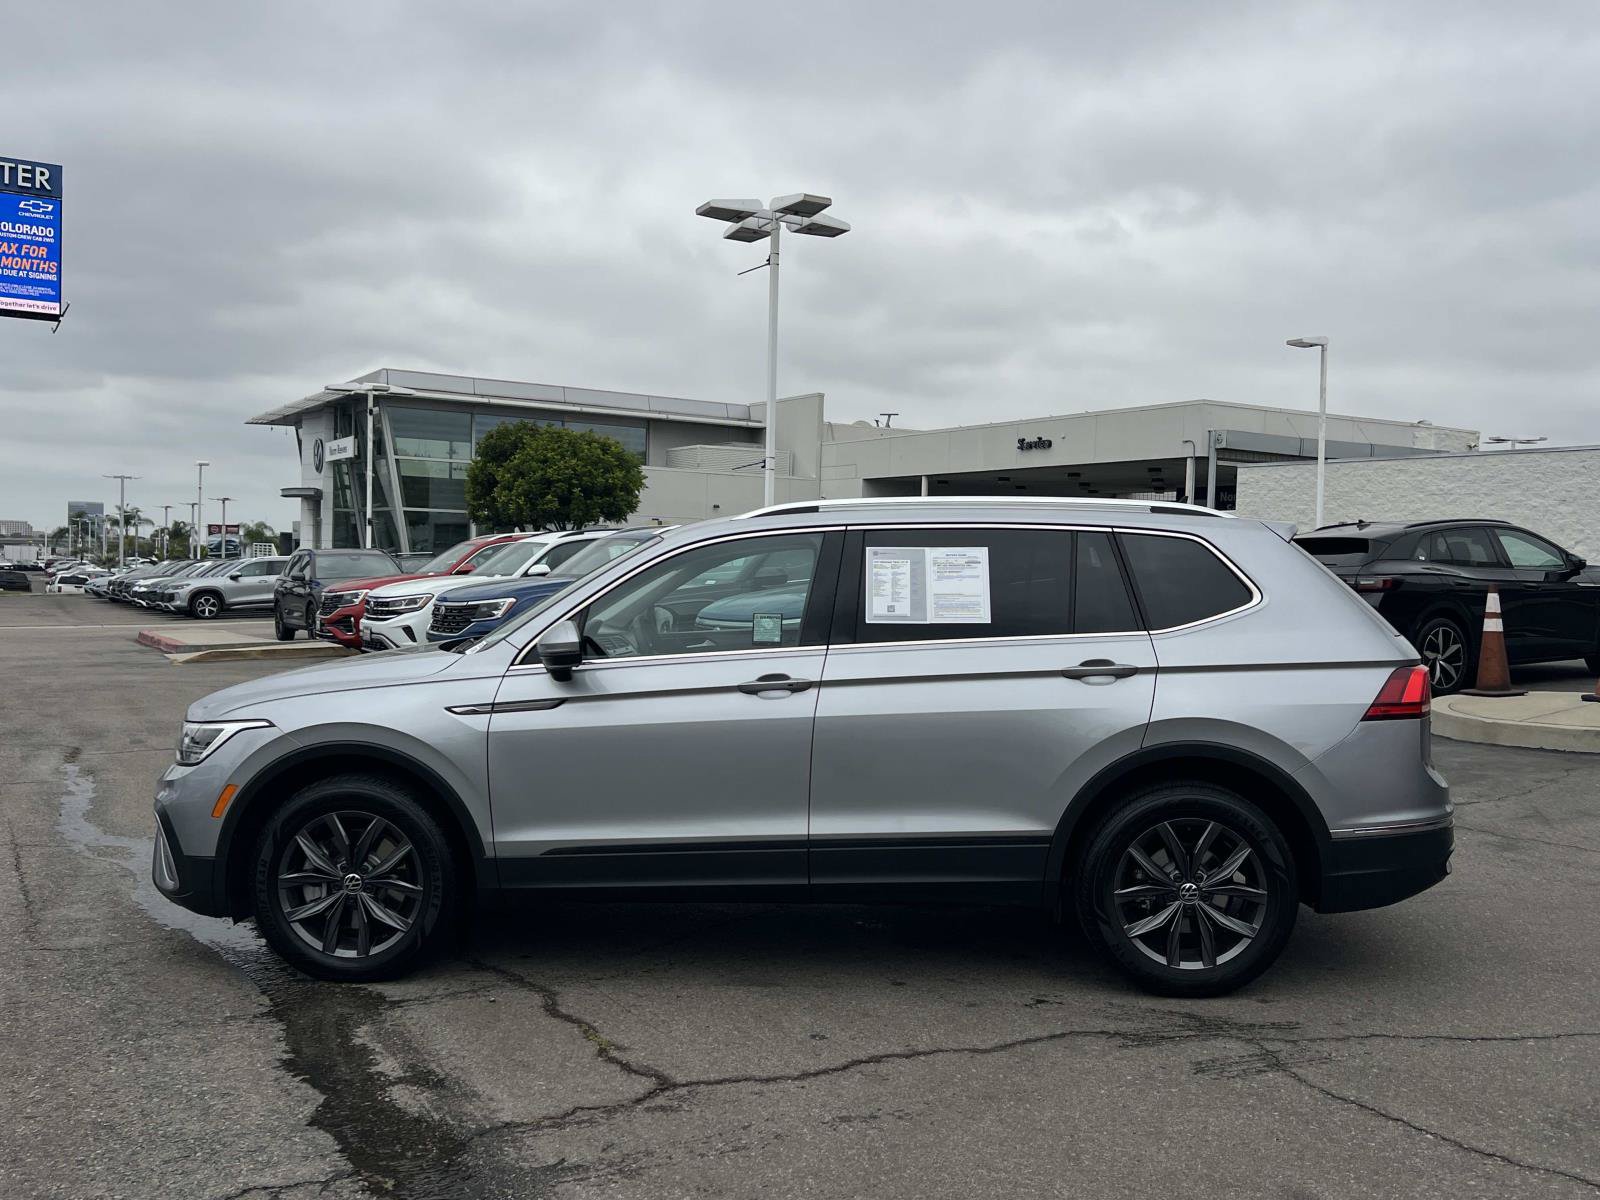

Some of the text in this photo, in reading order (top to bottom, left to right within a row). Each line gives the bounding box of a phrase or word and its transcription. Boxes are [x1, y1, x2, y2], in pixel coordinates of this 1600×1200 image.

[0, 162, 51, 190] TER
[18, 212, 54, 220] CHEVROLET
[21, 244, 47, 258] FOR
[1, 256, 57, 273] MONTHS
[28, 272, 57, 281] SIGNING
